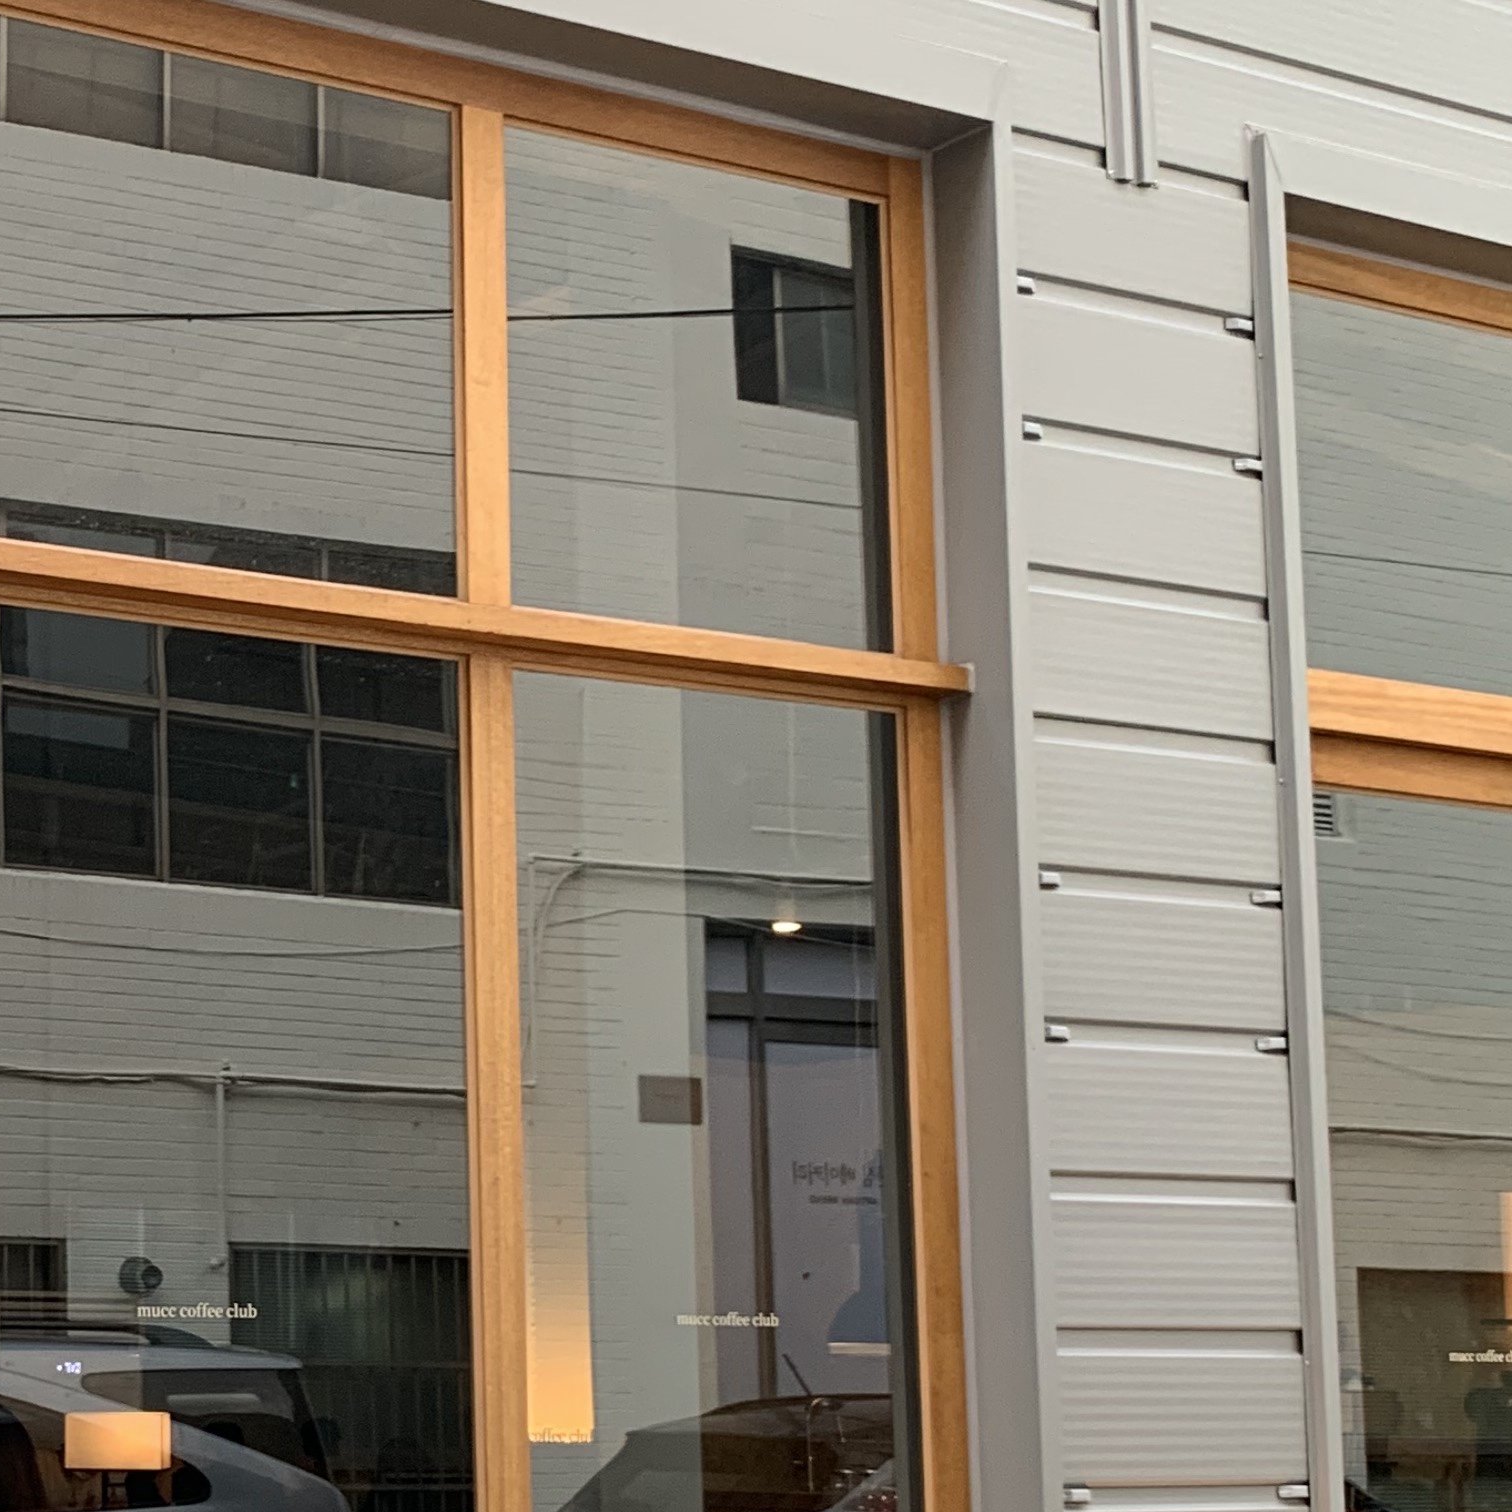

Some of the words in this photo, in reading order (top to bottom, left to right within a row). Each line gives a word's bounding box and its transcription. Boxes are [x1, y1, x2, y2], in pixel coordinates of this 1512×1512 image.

[137, 1305, 177, 1318] mucc
[179, 1302, 223, 1318] coffee
[226, 1303, 258, 1318] club
[676, 1314, 710, 1326] mucc
[712, 1311, 750, 1326] coffee
[752, 1312, 779, 1327] club
